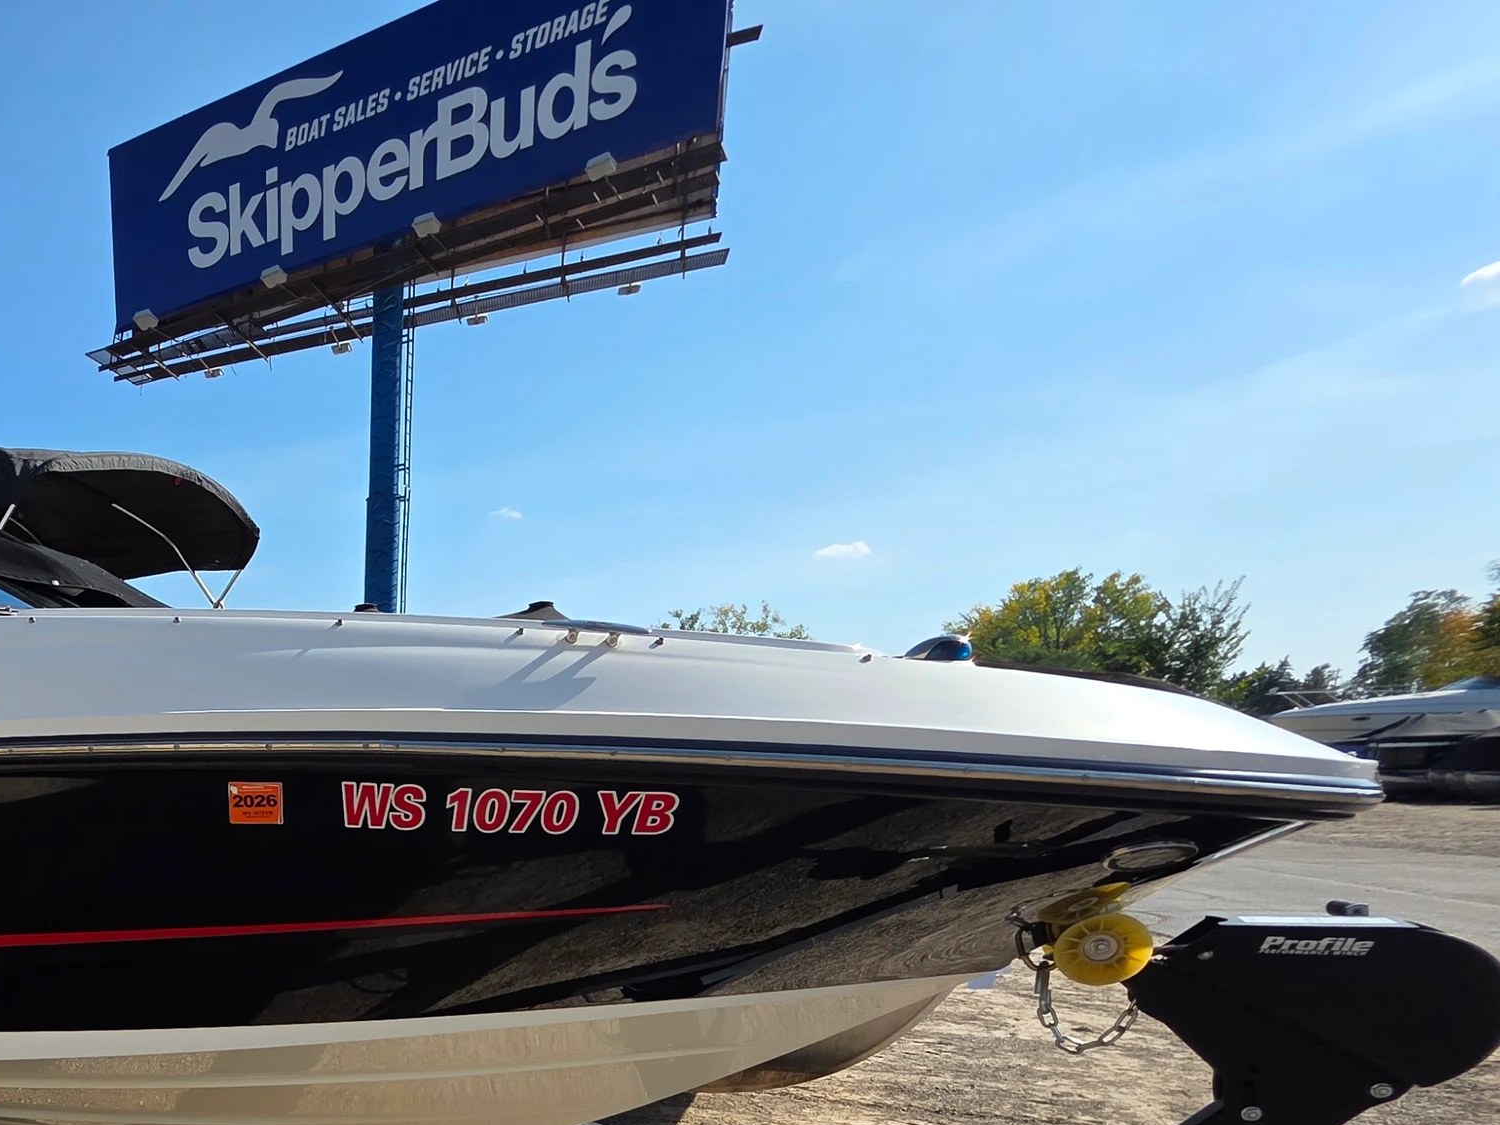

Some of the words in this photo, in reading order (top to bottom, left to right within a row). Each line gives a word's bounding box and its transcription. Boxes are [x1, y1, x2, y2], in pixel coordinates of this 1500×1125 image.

[285, 114, 330, 152] BOAT
[332, 87, 390, 131] SALES
[406, 45, 492, 101] SERVICE
[508, 0, 610, 60] STORAGE
[232, 794, 278, 808] 2026
[342, 781, 426, 831] WS
[446, 787, 580, 834] 1070
[597, 791, 680, 835] YB
[1260, 936, 1374, 951] Profile
